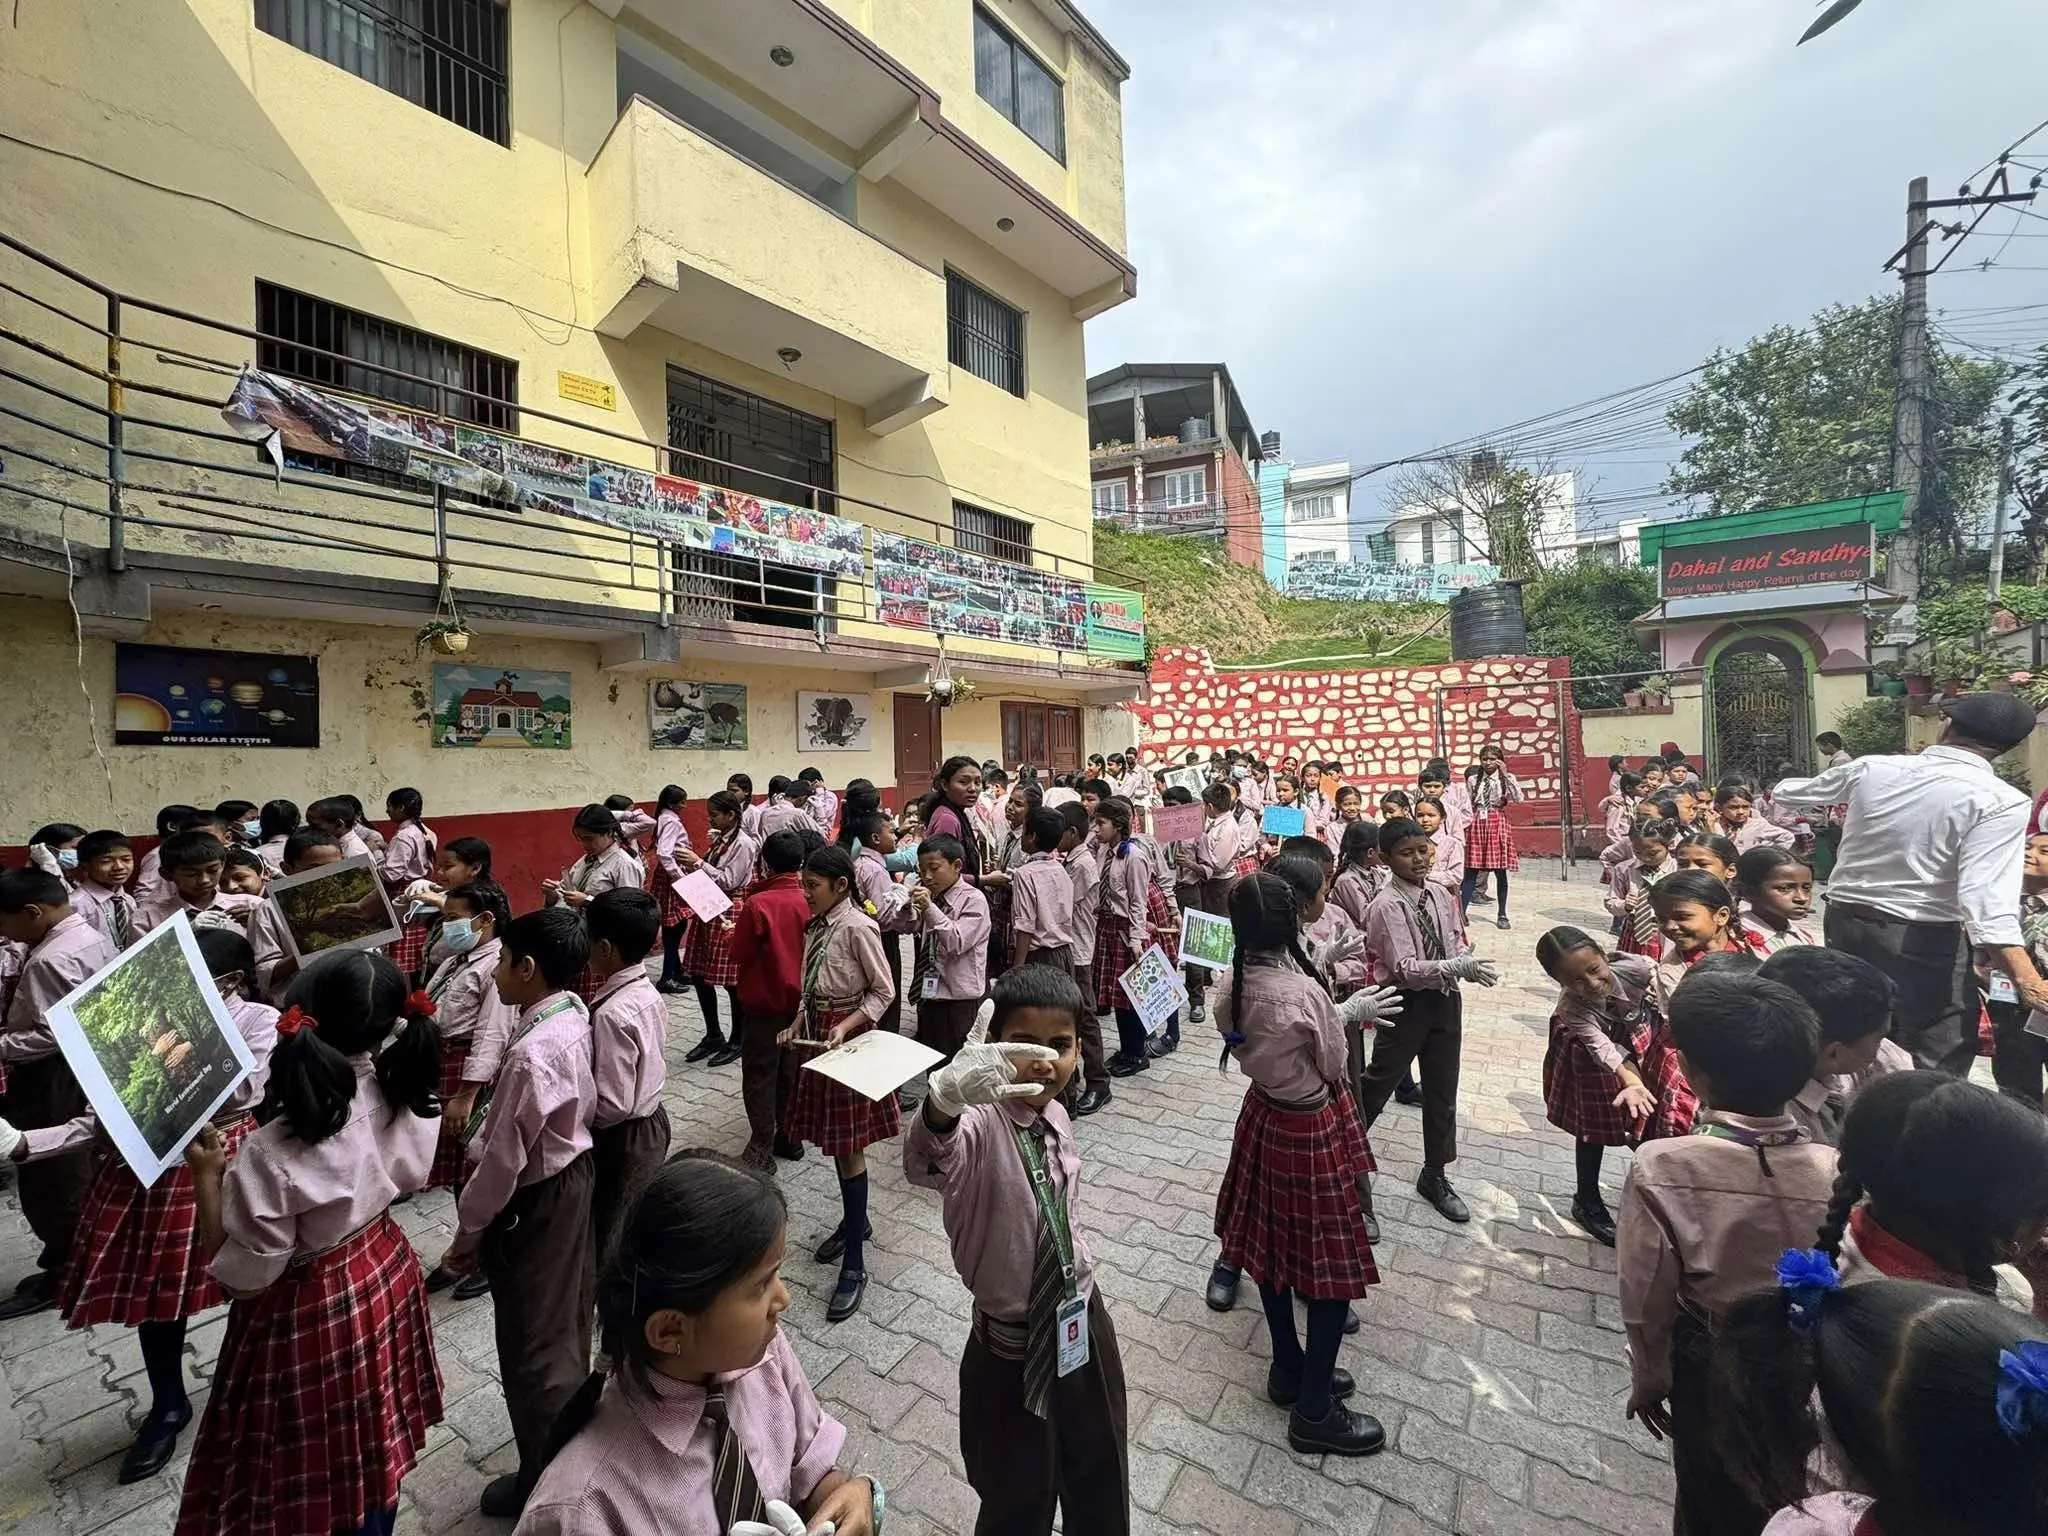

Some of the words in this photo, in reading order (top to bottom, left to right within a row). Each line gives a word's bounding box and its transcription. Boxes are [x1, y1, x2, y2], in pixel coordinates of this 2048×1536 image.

[1668, 556, 1726, 579] Dahal
[1730, 551, 1772, 572] and
[1667, 584, 1693, 596] Many
[1696, 583, 1723, 593] Many
[1726, 578, 1760, 590] Happy
[1764, 574, 1805, 585] Returns
[1808, 572, 1818, 581] of
[1820, 570, 1837, 580] the
